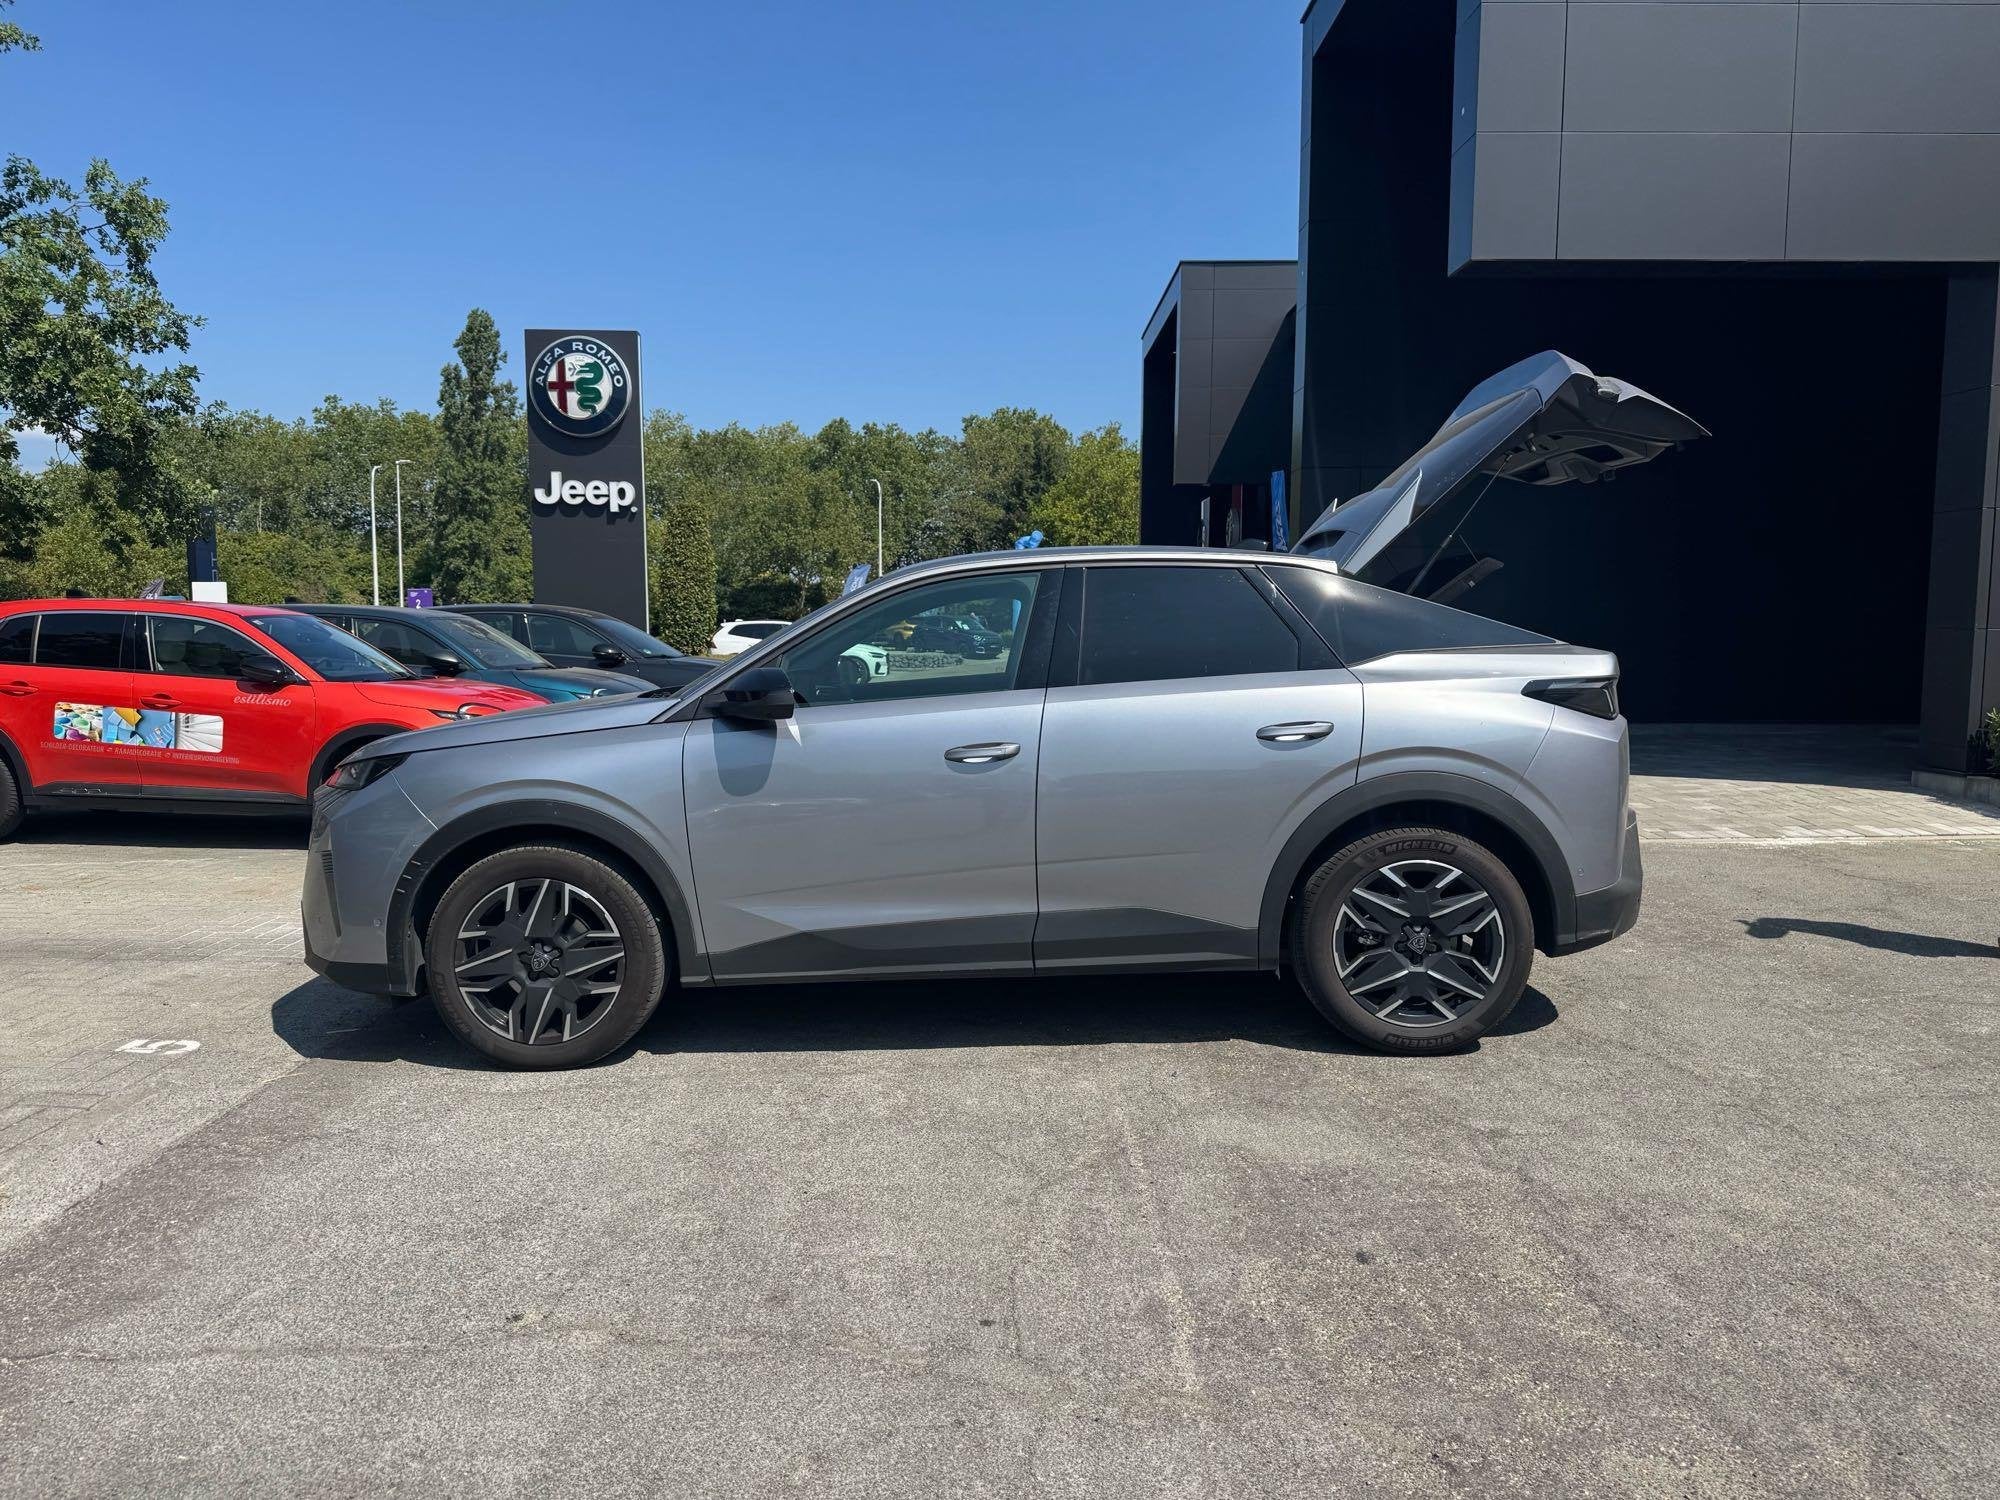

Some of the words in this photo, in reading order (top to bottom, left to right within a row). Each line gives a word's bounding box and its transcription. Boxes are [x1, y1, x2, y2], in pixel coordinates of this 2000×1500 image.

[533, 346, 565, 388] ALFA
[571, 341, 624, 388] ROMEO
[415, 599, 422, 609] 2
[233, 693, 292, 707] estilismo
[1385, 841, 1455, 854] MICHELIN
[114, 1039, 201, 1054] 5
